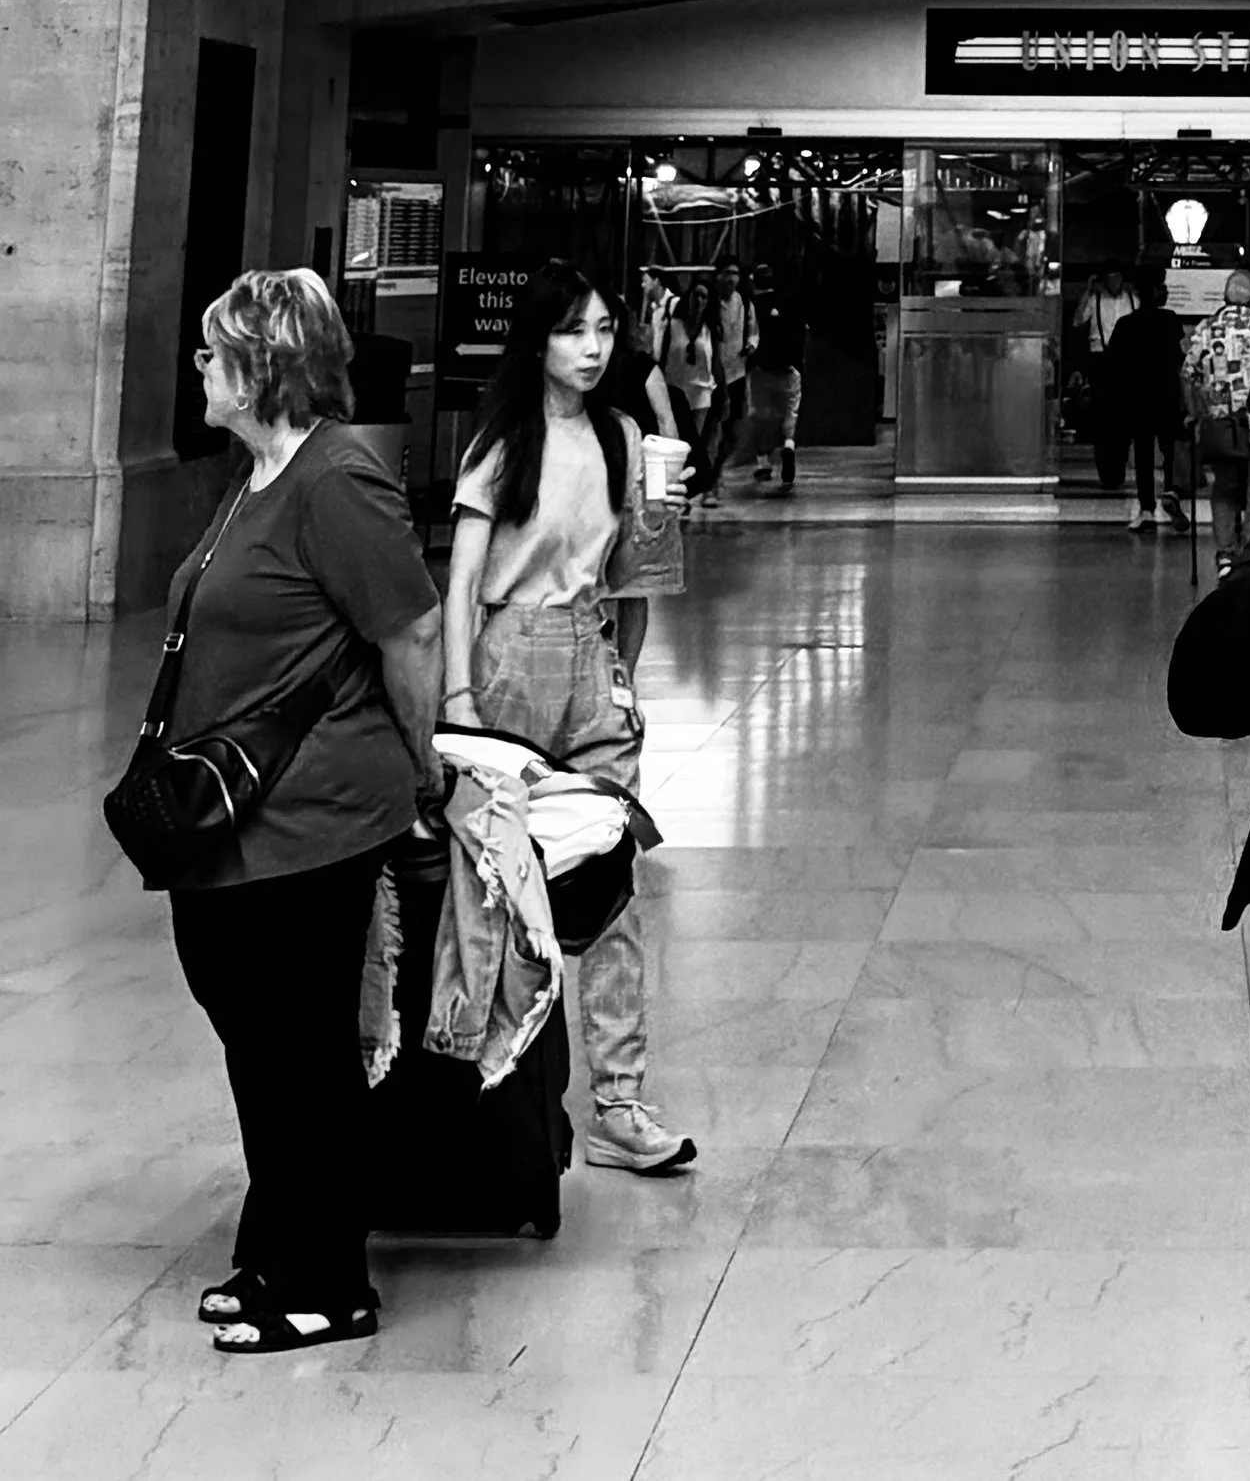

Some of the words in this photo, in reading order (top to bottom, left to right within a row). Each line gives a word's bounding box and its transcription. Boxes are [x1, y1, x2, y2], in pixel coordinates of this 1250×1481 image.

[1022, 30, 1159, 72] UNION
[458, 267, 529, 286] Elevato
[478, 291, 514, 309] this
[474, 318, 512, 338] way
